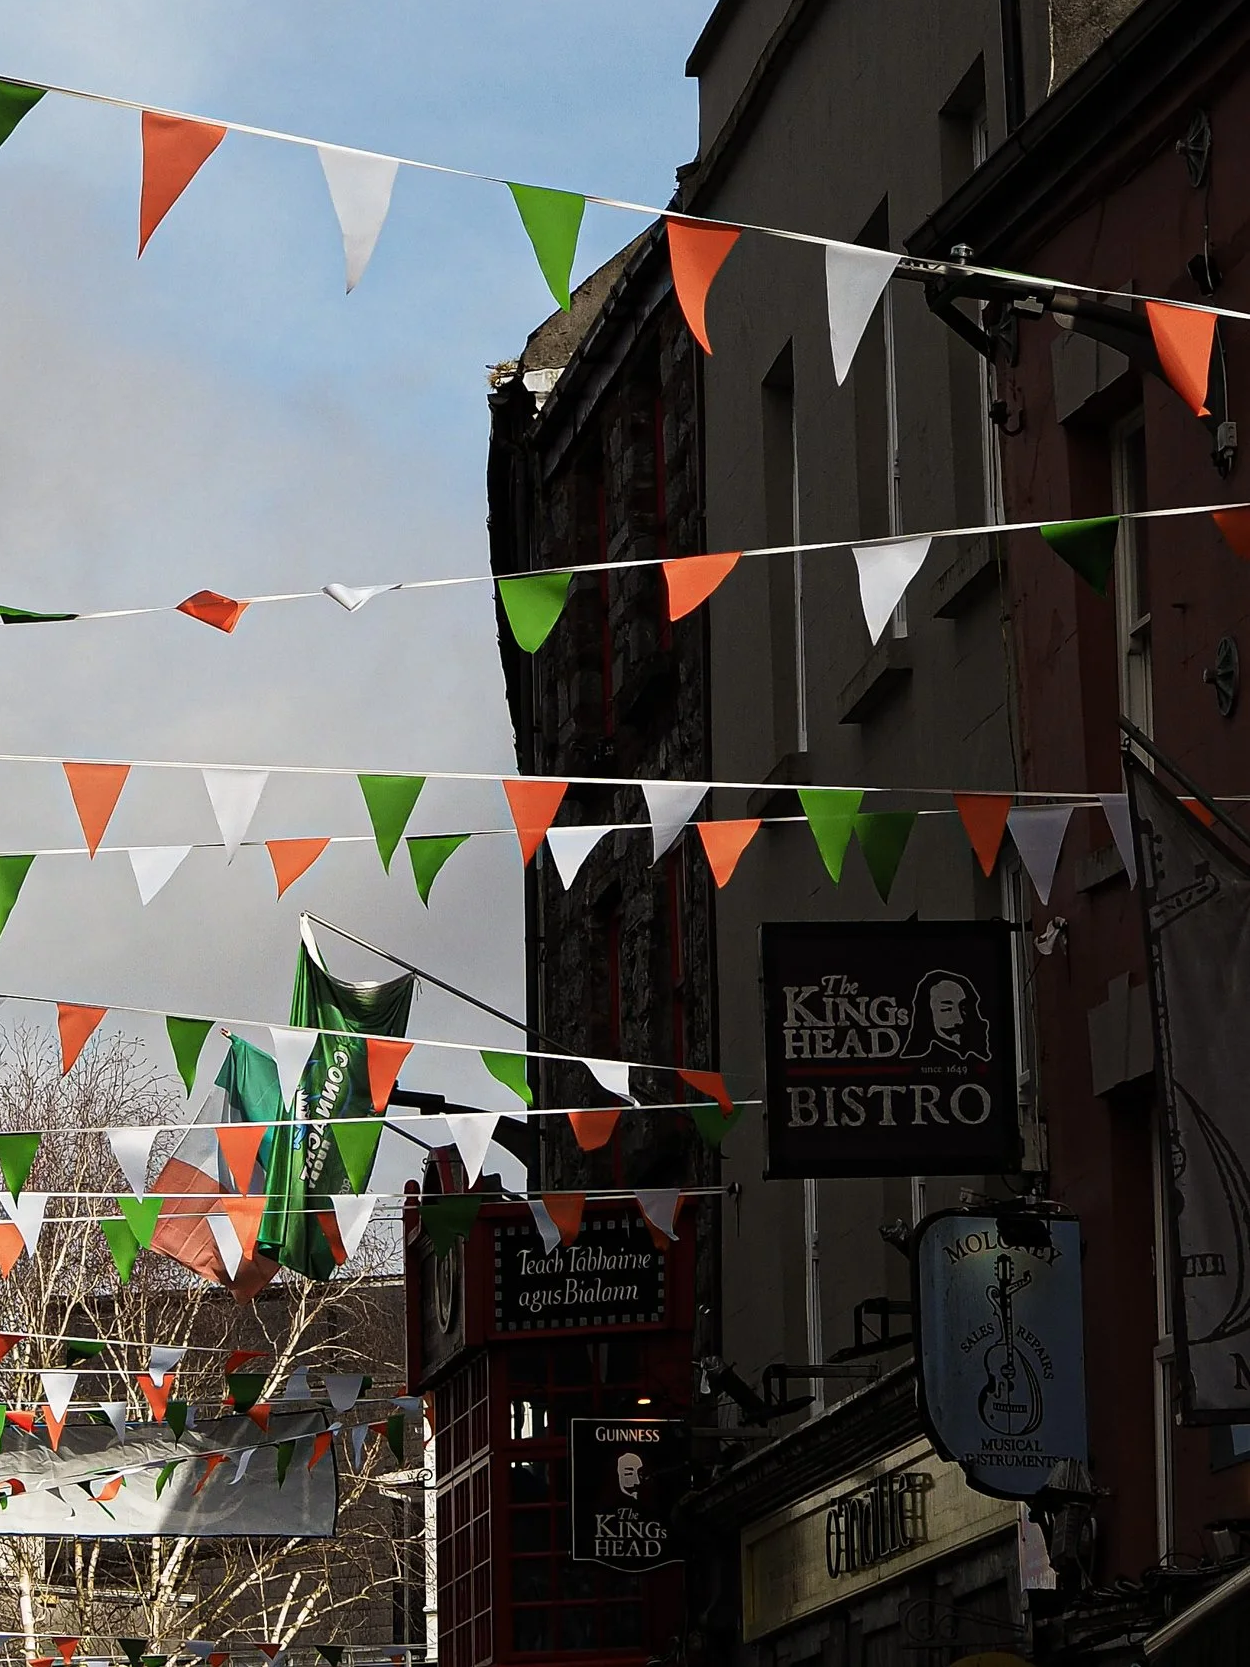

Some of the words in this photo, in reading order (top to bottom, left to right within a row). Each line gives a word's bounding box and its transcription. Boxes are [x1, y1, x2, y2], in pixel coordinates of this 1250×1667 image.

[821, 975, 858, 996] The
[783, 1028, 901, 1059] HEAD
[946, 1065, 968, 1076] 1649
[786, 1083, 992, 1128] BISTRO
[516, 1248, 564, 1276] Teach
[518, 1289, 562, 1313] agus
[563, 1277, 640, 1306] Bialann
[960, 1322, 995, 1354] SALES
[1016, 1324, 1054, 1380] REPAIRS
[595, 1426, 660, 1442] GUINNESS
[981, 1438, 1043, 1452] MUSICAL
[617, 1507, 640, 1521] The
[594, 1539, 662, 1557] HEAD
